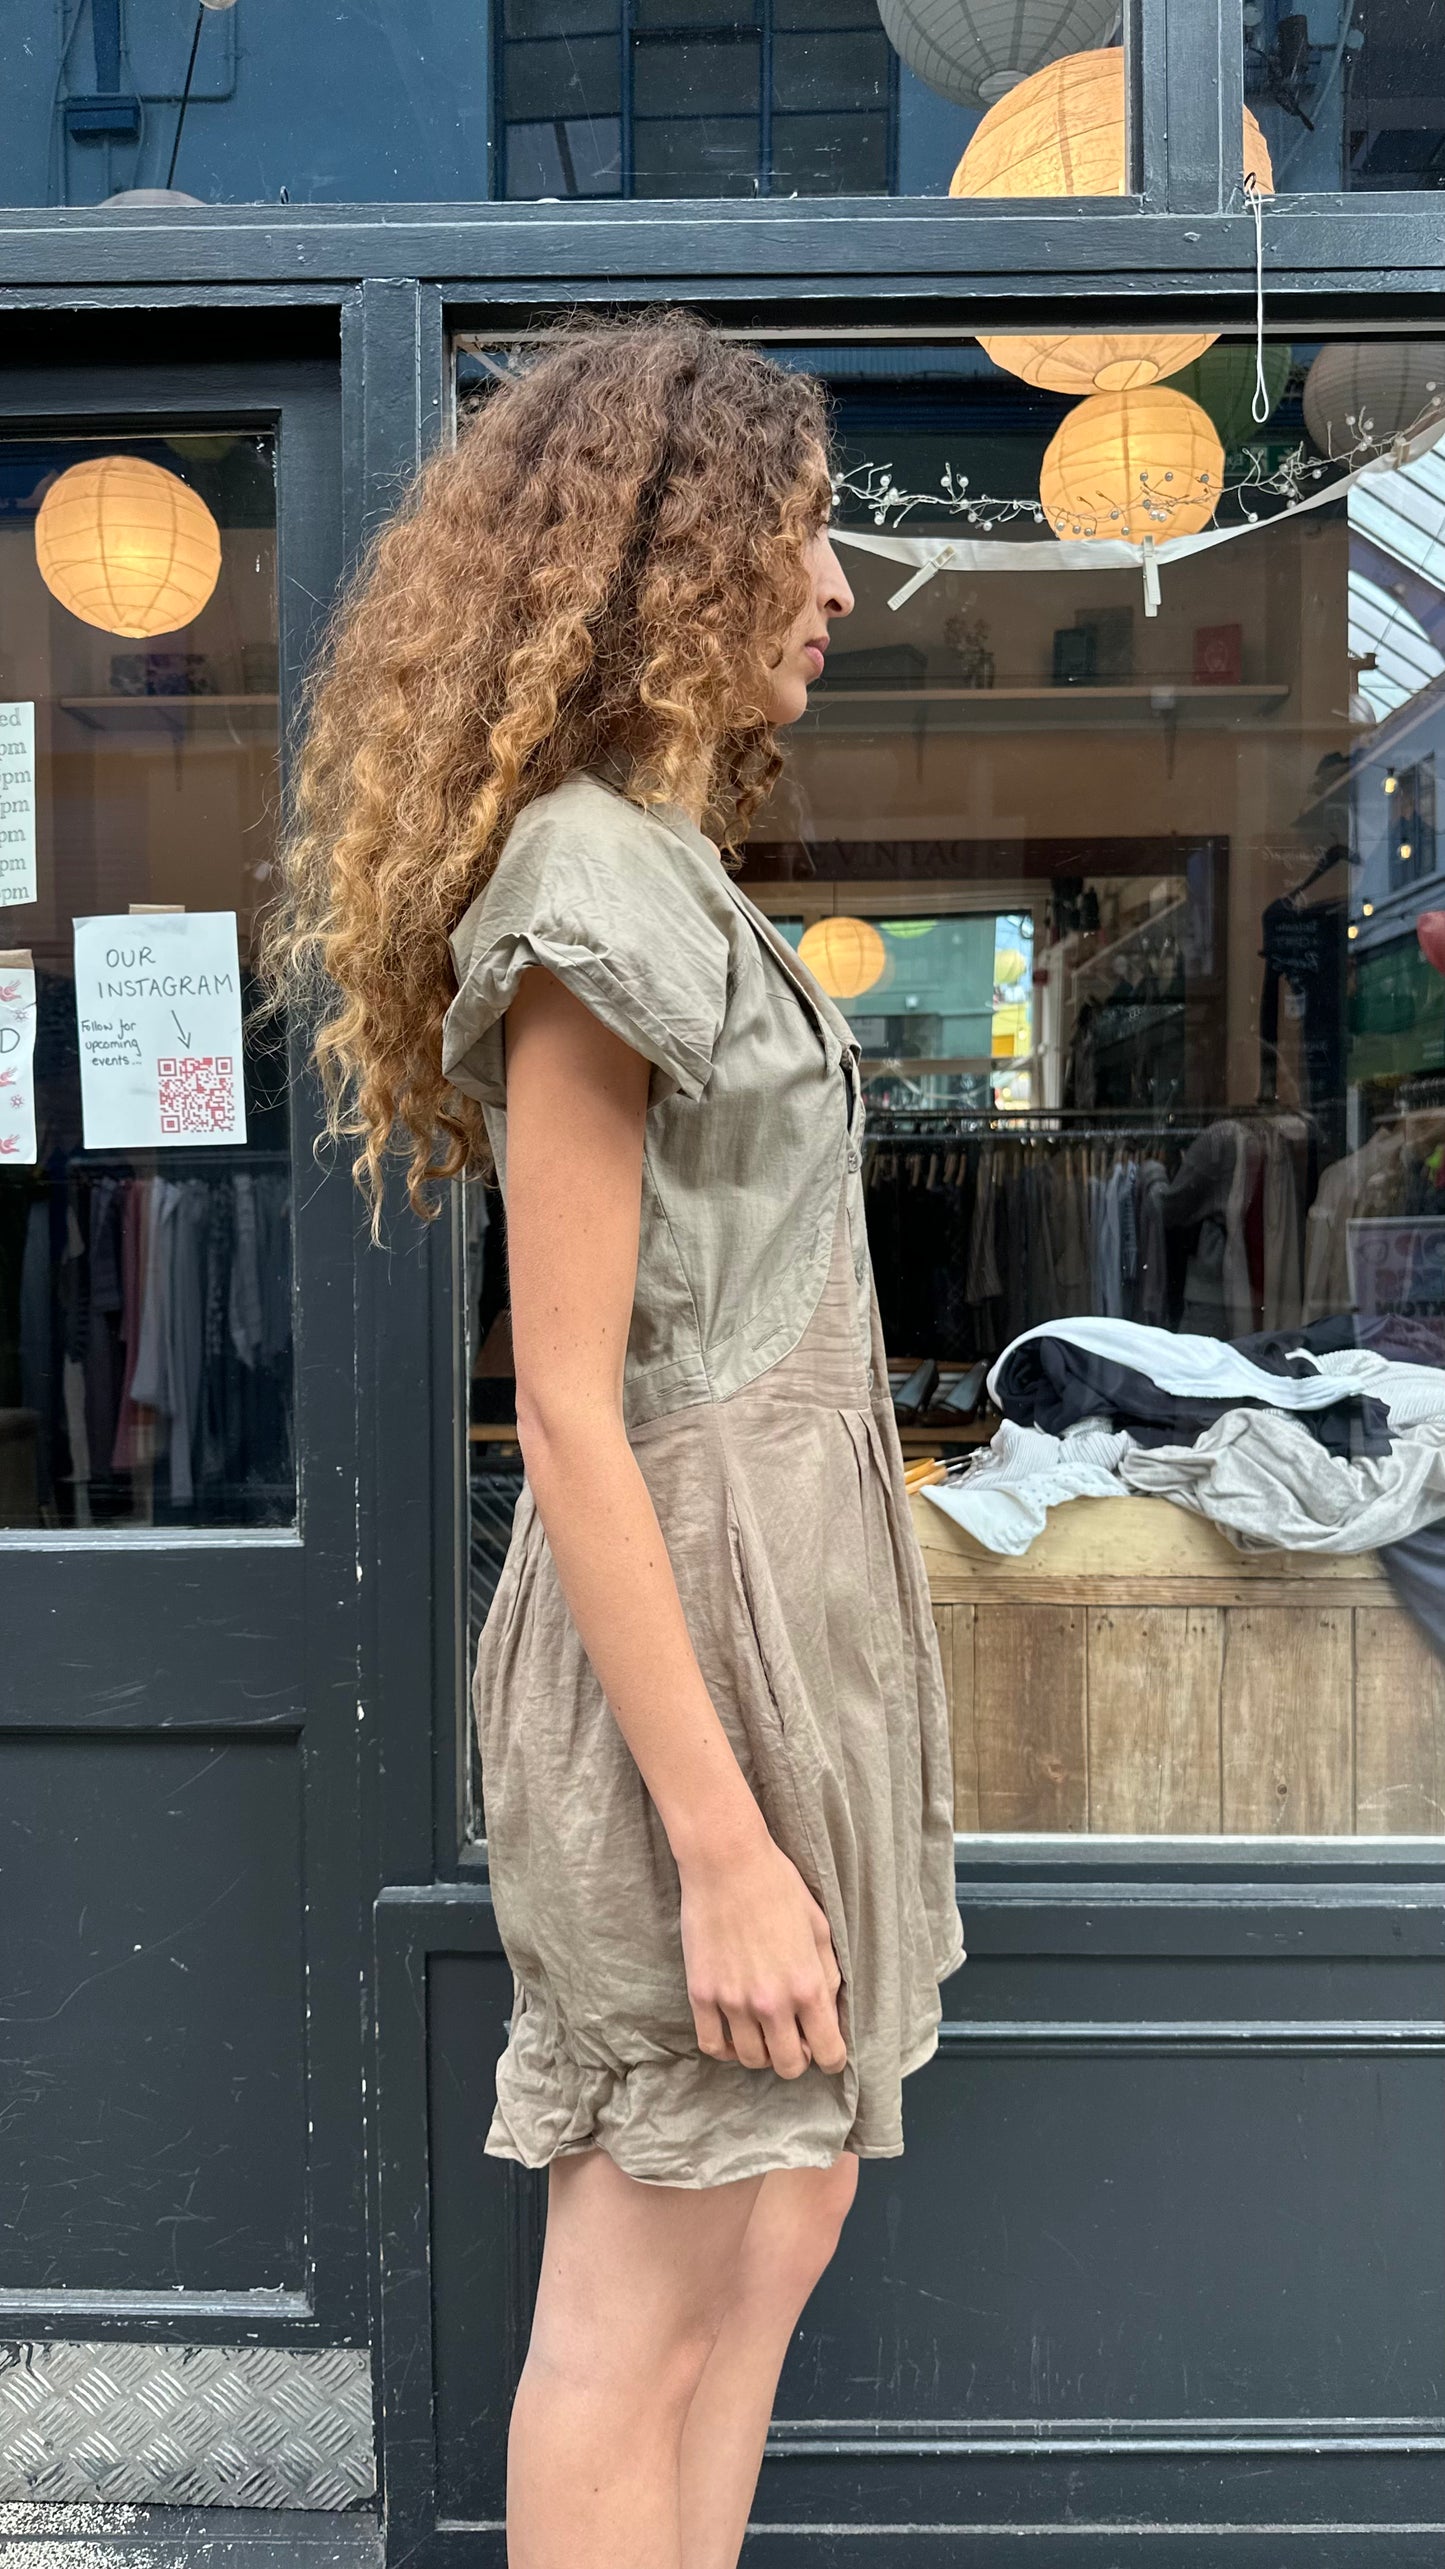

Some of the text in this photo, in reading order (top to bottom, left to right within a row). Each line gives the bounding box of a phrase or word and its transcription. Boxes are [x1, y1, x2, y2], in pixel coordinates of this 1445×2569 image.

[1, 769, 31, 791] pm
[0, 798, 30, 820] pm
[1, 886, 30, 905] pm
[106, 946, 156, 968] OUR
[98, 973, 233, 999] INSTAGRAM
[81, 1018, 137, 1040] Follow for
[85, 1038, 142, 1057] upcoming
